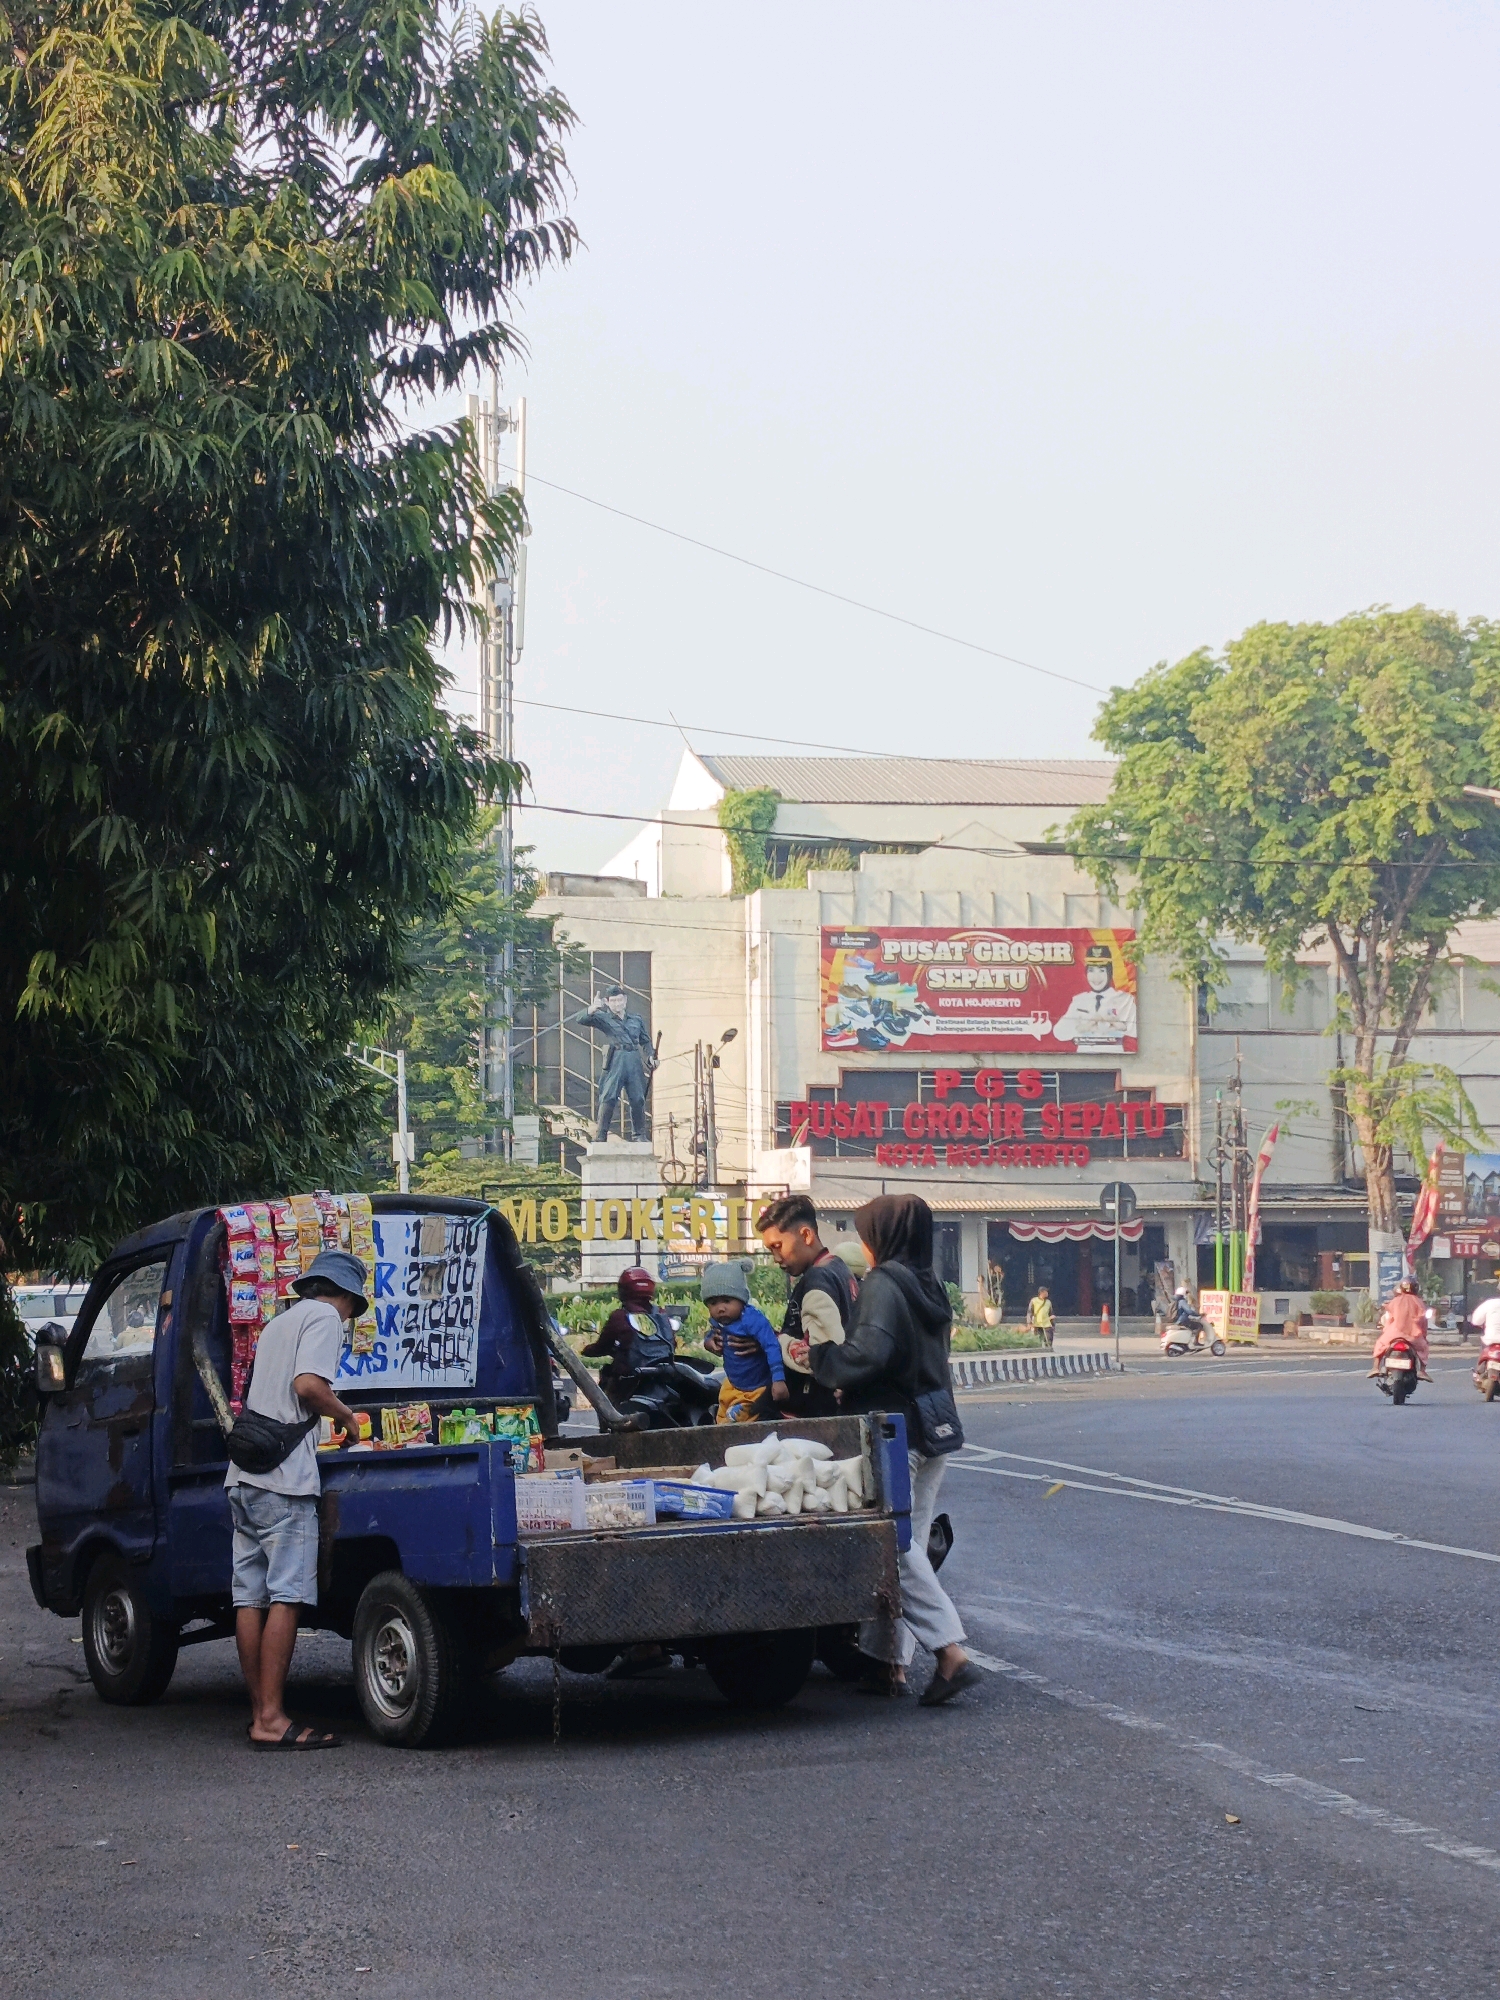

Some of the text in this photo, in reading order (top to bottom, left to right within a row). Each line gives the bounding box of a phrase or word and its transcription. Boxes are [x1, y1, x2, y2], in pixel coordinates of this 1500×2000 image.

[883, 940, 967, 963] PUSAT
[972, 940, 1074, 963] GROSIR
[926, 966, 1029, 991] SEPATU
[938, 997, 1022, 1008] KOTA MOJOKERTO
[790, 1101, 1166, 1140] PUSAT GROSIR SEPATU
[876, 1143, 1090, 1168] KOTA MOJOKERTO
[1230, 1294, 1258, 1307] EMPON
[1229, 1306, 1257, 1319] EMPON
